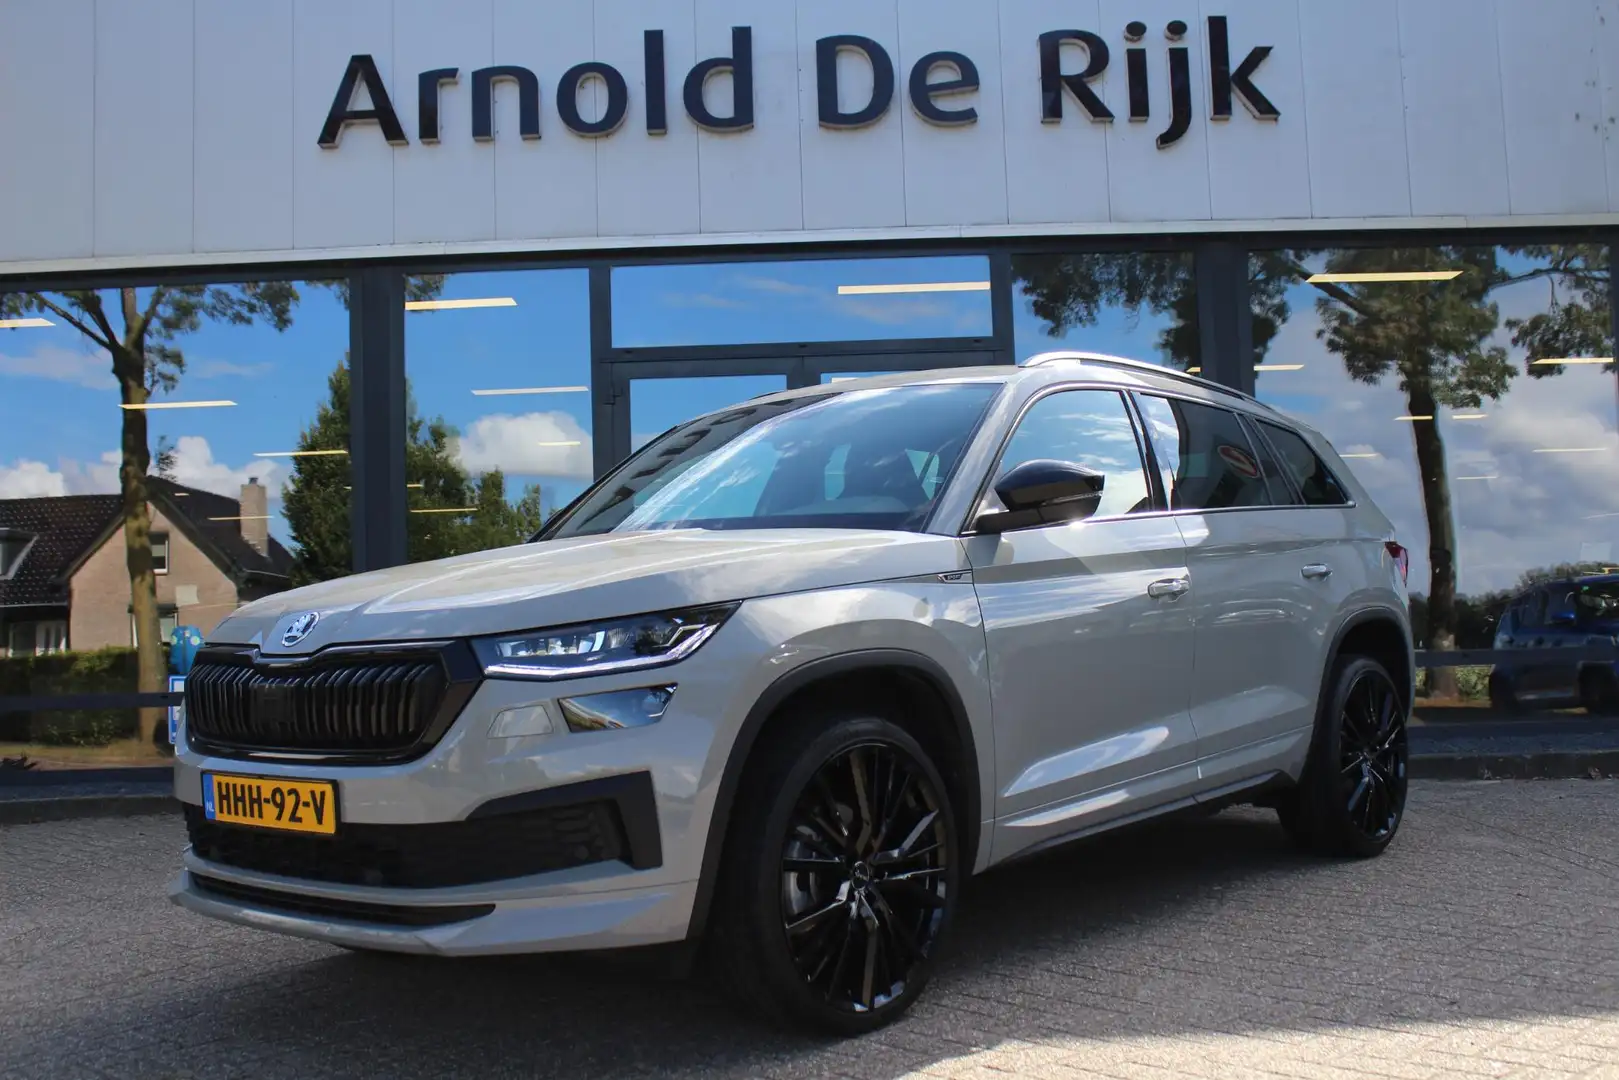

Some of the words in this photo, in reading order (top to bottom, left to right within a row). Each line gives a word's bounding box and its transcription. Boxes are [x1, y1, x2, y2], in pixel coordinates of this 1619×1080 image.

[317, 26, 754, 149] Arnold
[816, 34, 980, 129] De
[1038, 15, 1280, 149] Rijk
[217, 782, 326, 825] HHH-92-V
